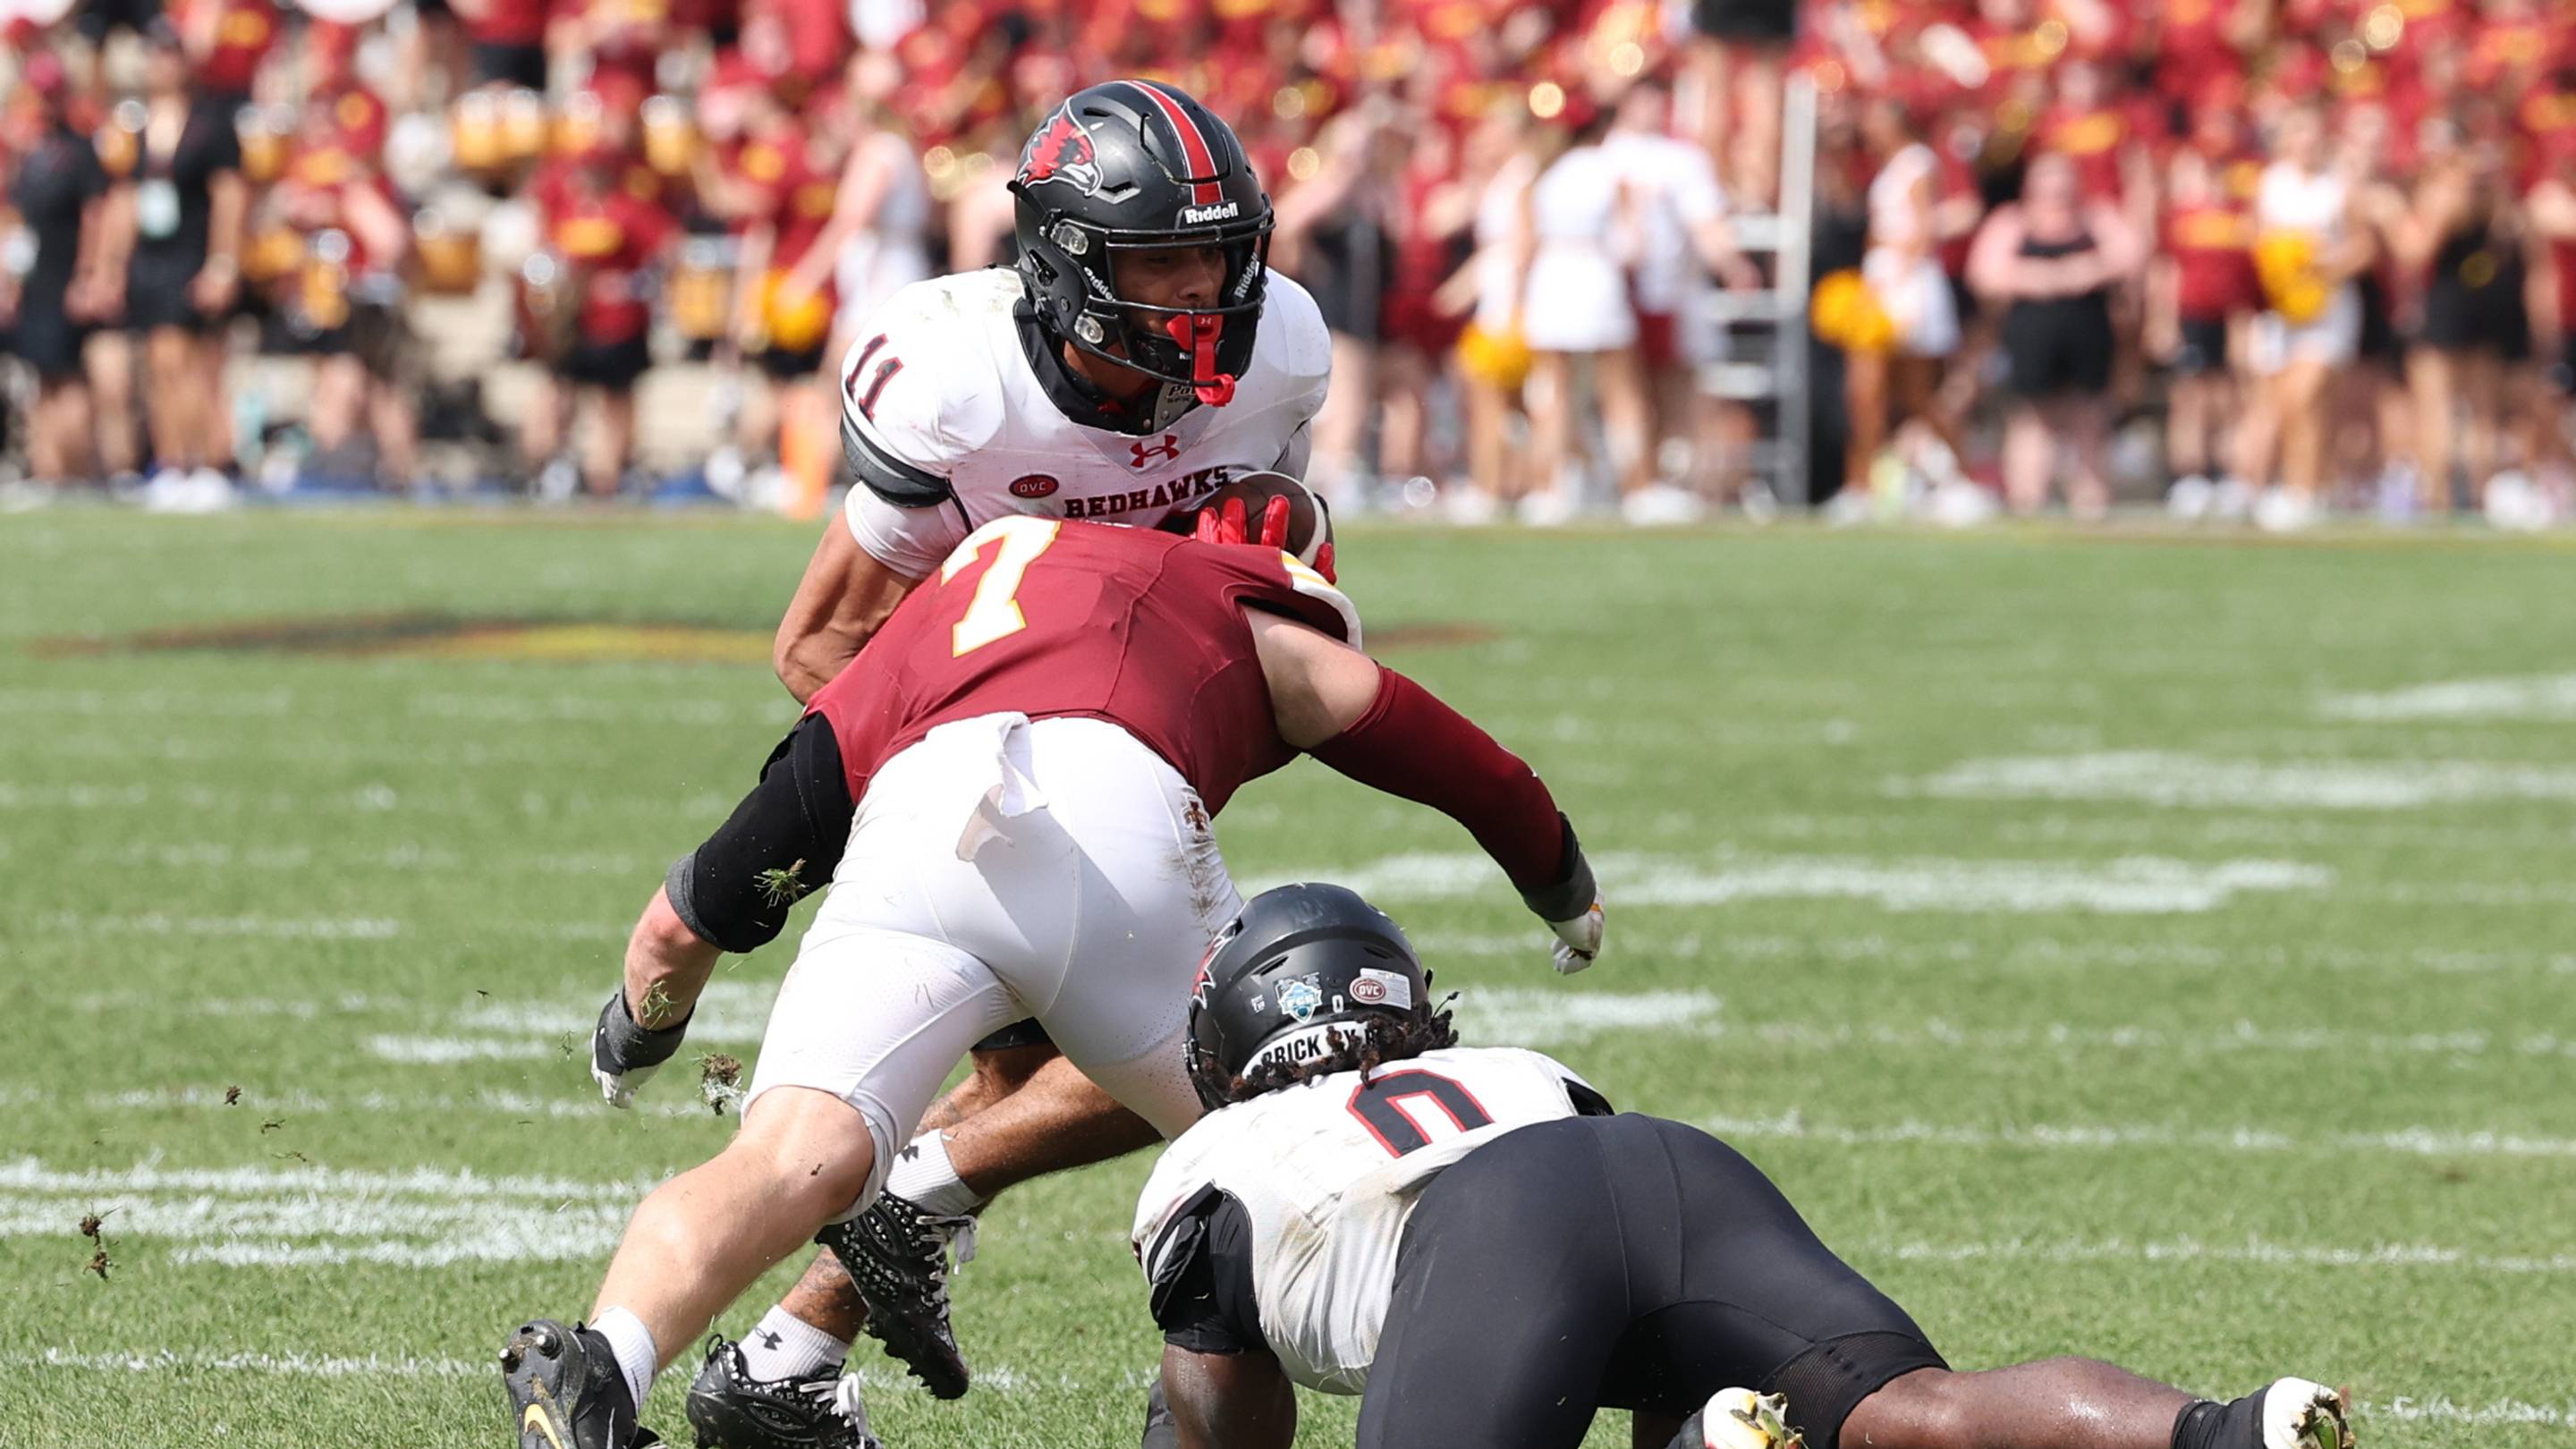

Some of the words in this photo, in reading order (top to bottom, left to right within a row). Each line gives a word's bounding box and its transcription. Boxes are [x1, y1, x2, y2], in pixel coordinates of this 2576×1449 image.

[1184, 202, 1239, 224] Riddell
[845, 333, 903, 428] 11
[1020, 482, 1046, 493] OVC
[1063, 465, 1228, 519] REDHAWKS
[940, 514, 1062, 658] 7
[1331, 995, 1344, 1013] 0
[1359, 985, 1379, 996] OVC
[1261, 1034, 1323, 1067] BRICK
